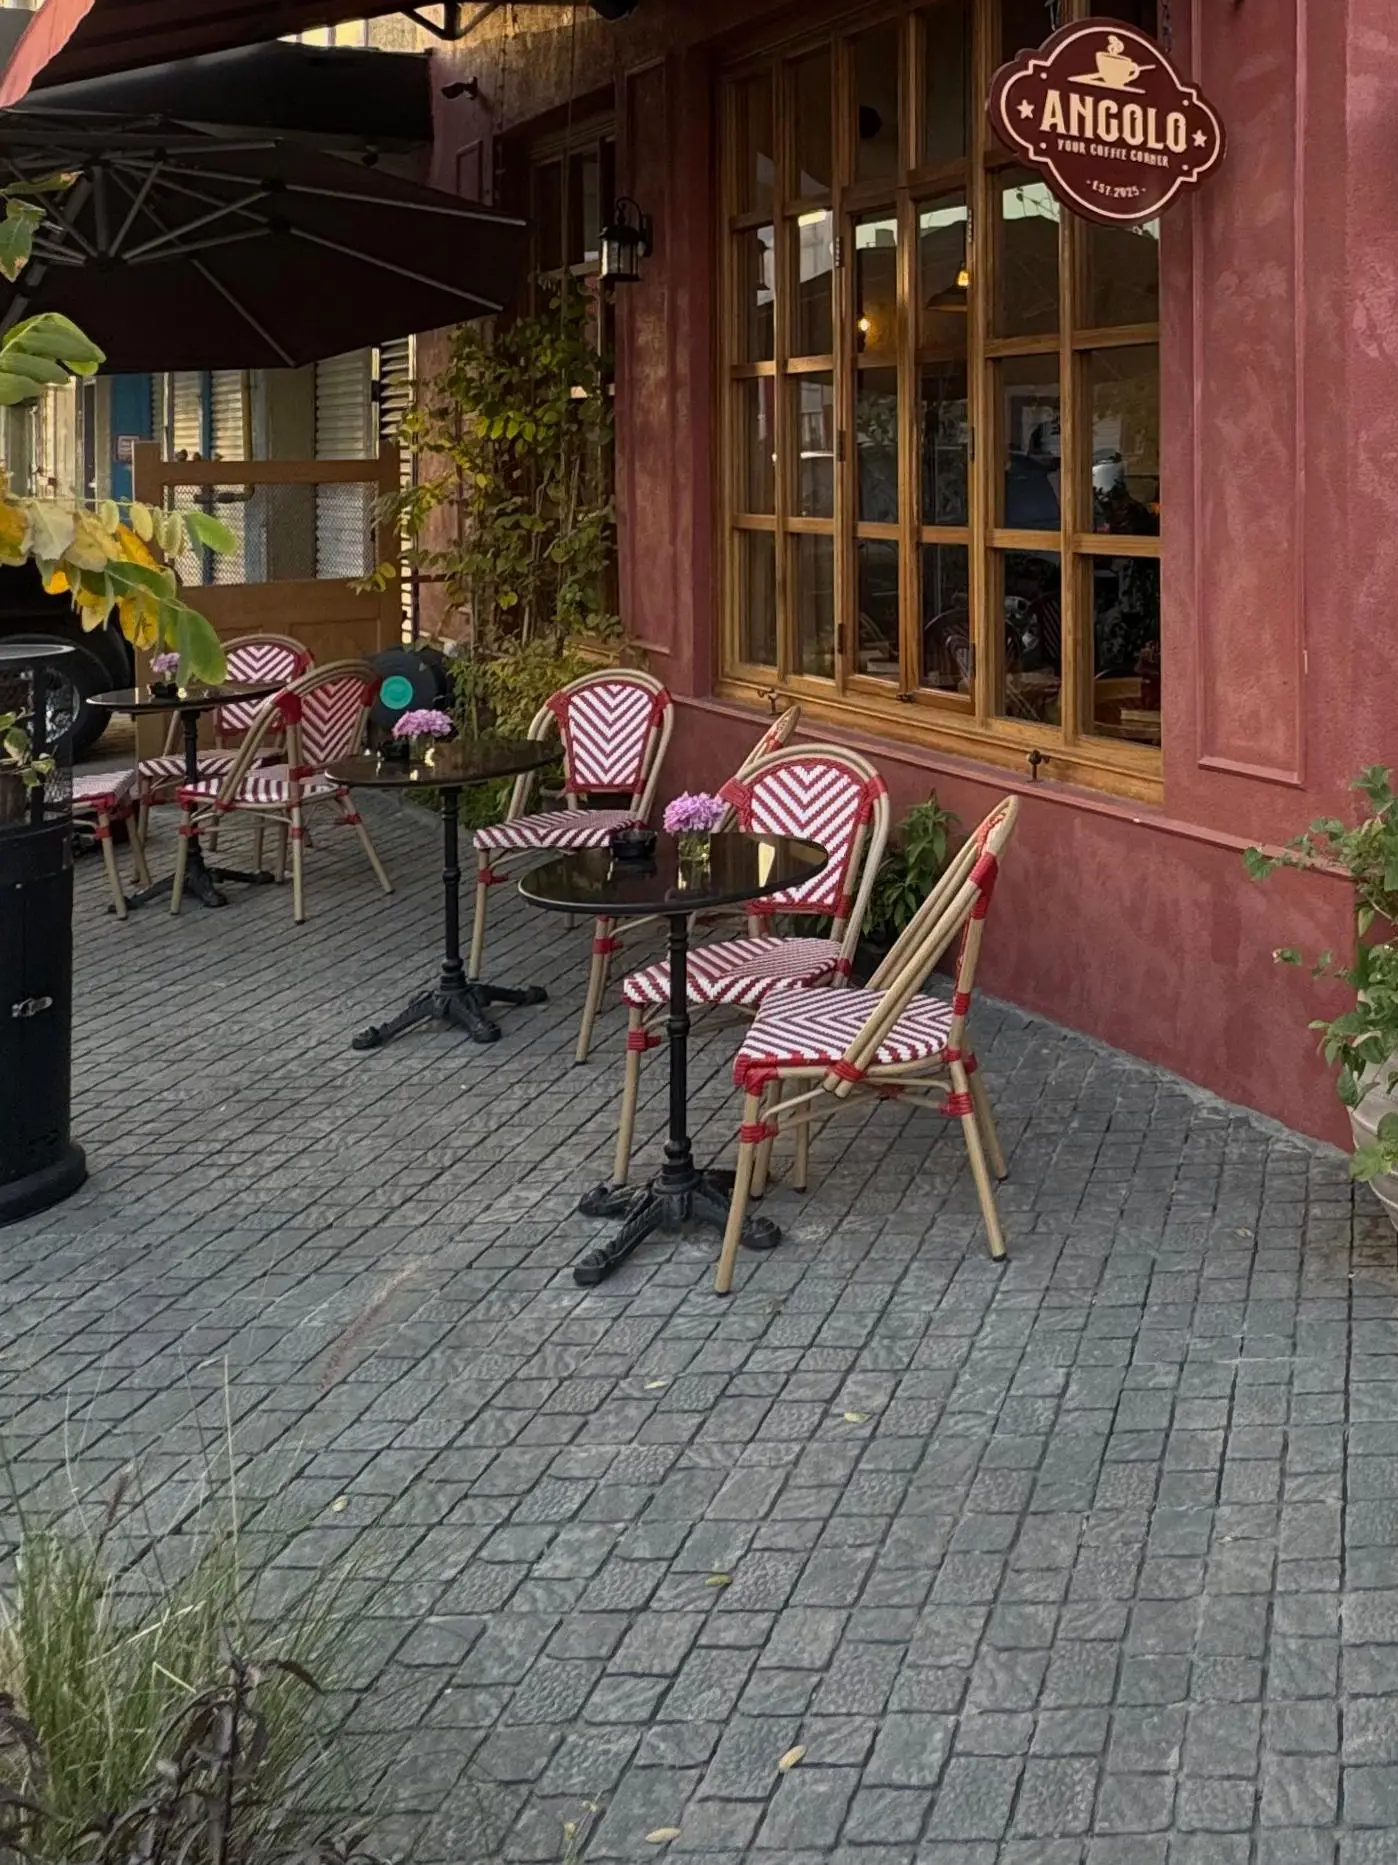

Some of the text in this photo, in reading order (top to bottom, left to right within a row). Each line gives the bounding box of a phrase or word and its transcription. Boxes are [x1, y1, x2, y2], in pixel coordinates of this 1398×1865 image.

[1040, 89, 1188, 153] ANGOLO
[1058, 139, 1169, 168] YOUR COFFEE CORNER
